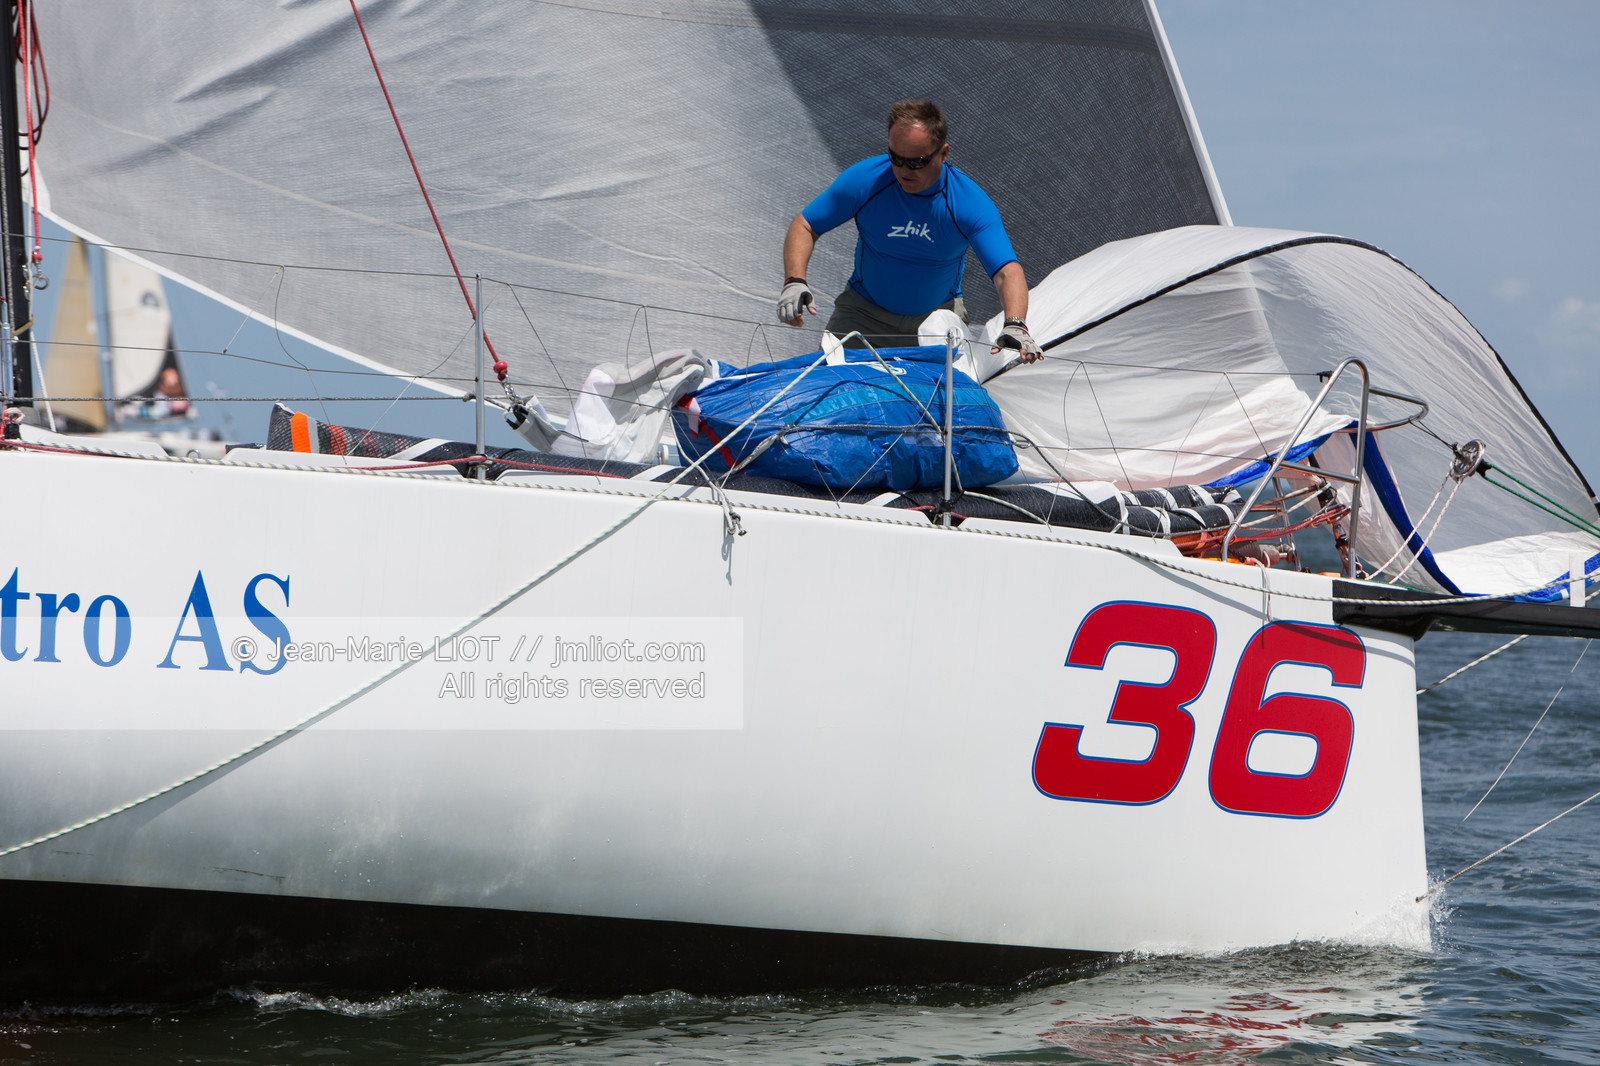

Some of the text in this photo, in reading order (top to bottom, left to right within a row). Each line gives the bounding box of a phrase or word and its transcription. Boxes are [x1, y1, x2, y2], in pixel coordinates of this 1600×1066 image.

[887, 220, 932, 241] zhik
[0, 567, 291, 676] tro AS
[1031, 599, 1367, 820] 36
